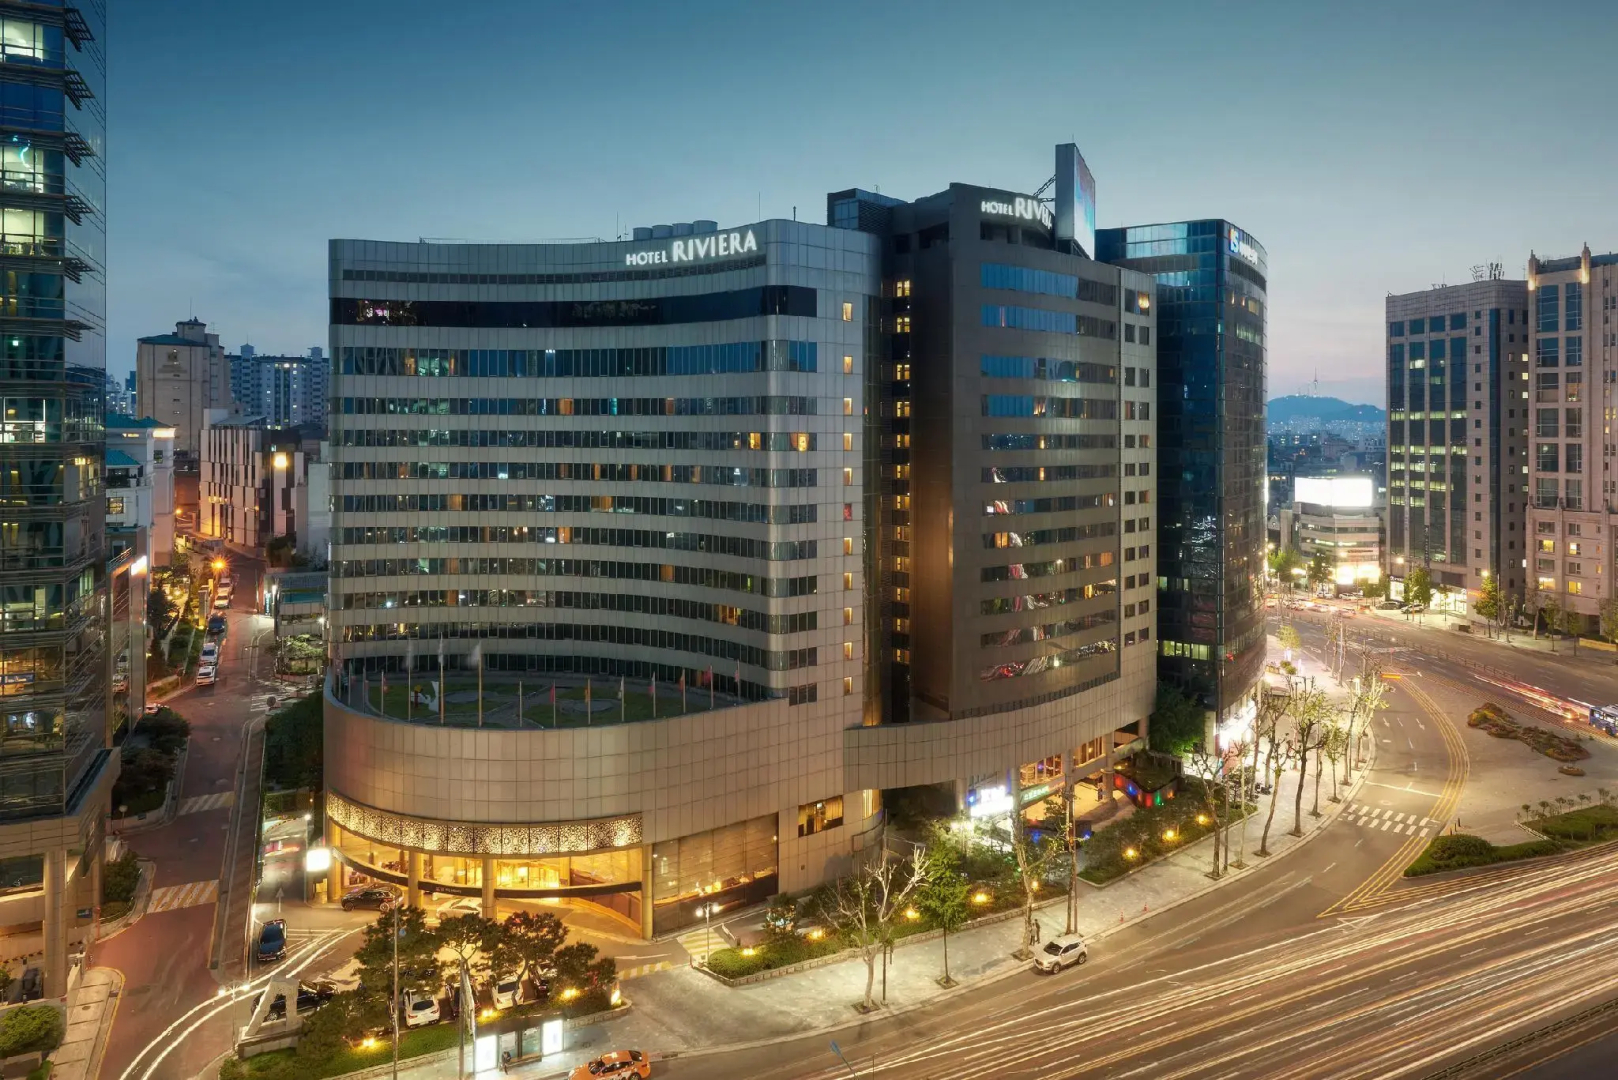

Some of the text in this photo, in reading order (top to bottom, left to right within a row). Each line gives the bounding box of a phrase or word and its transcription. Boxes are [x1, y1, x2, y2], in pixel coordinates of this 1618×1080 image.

[981, 200, 1014, 216] HOTEL
[625, 229, 758, 266] HOTEL RIVIERA
